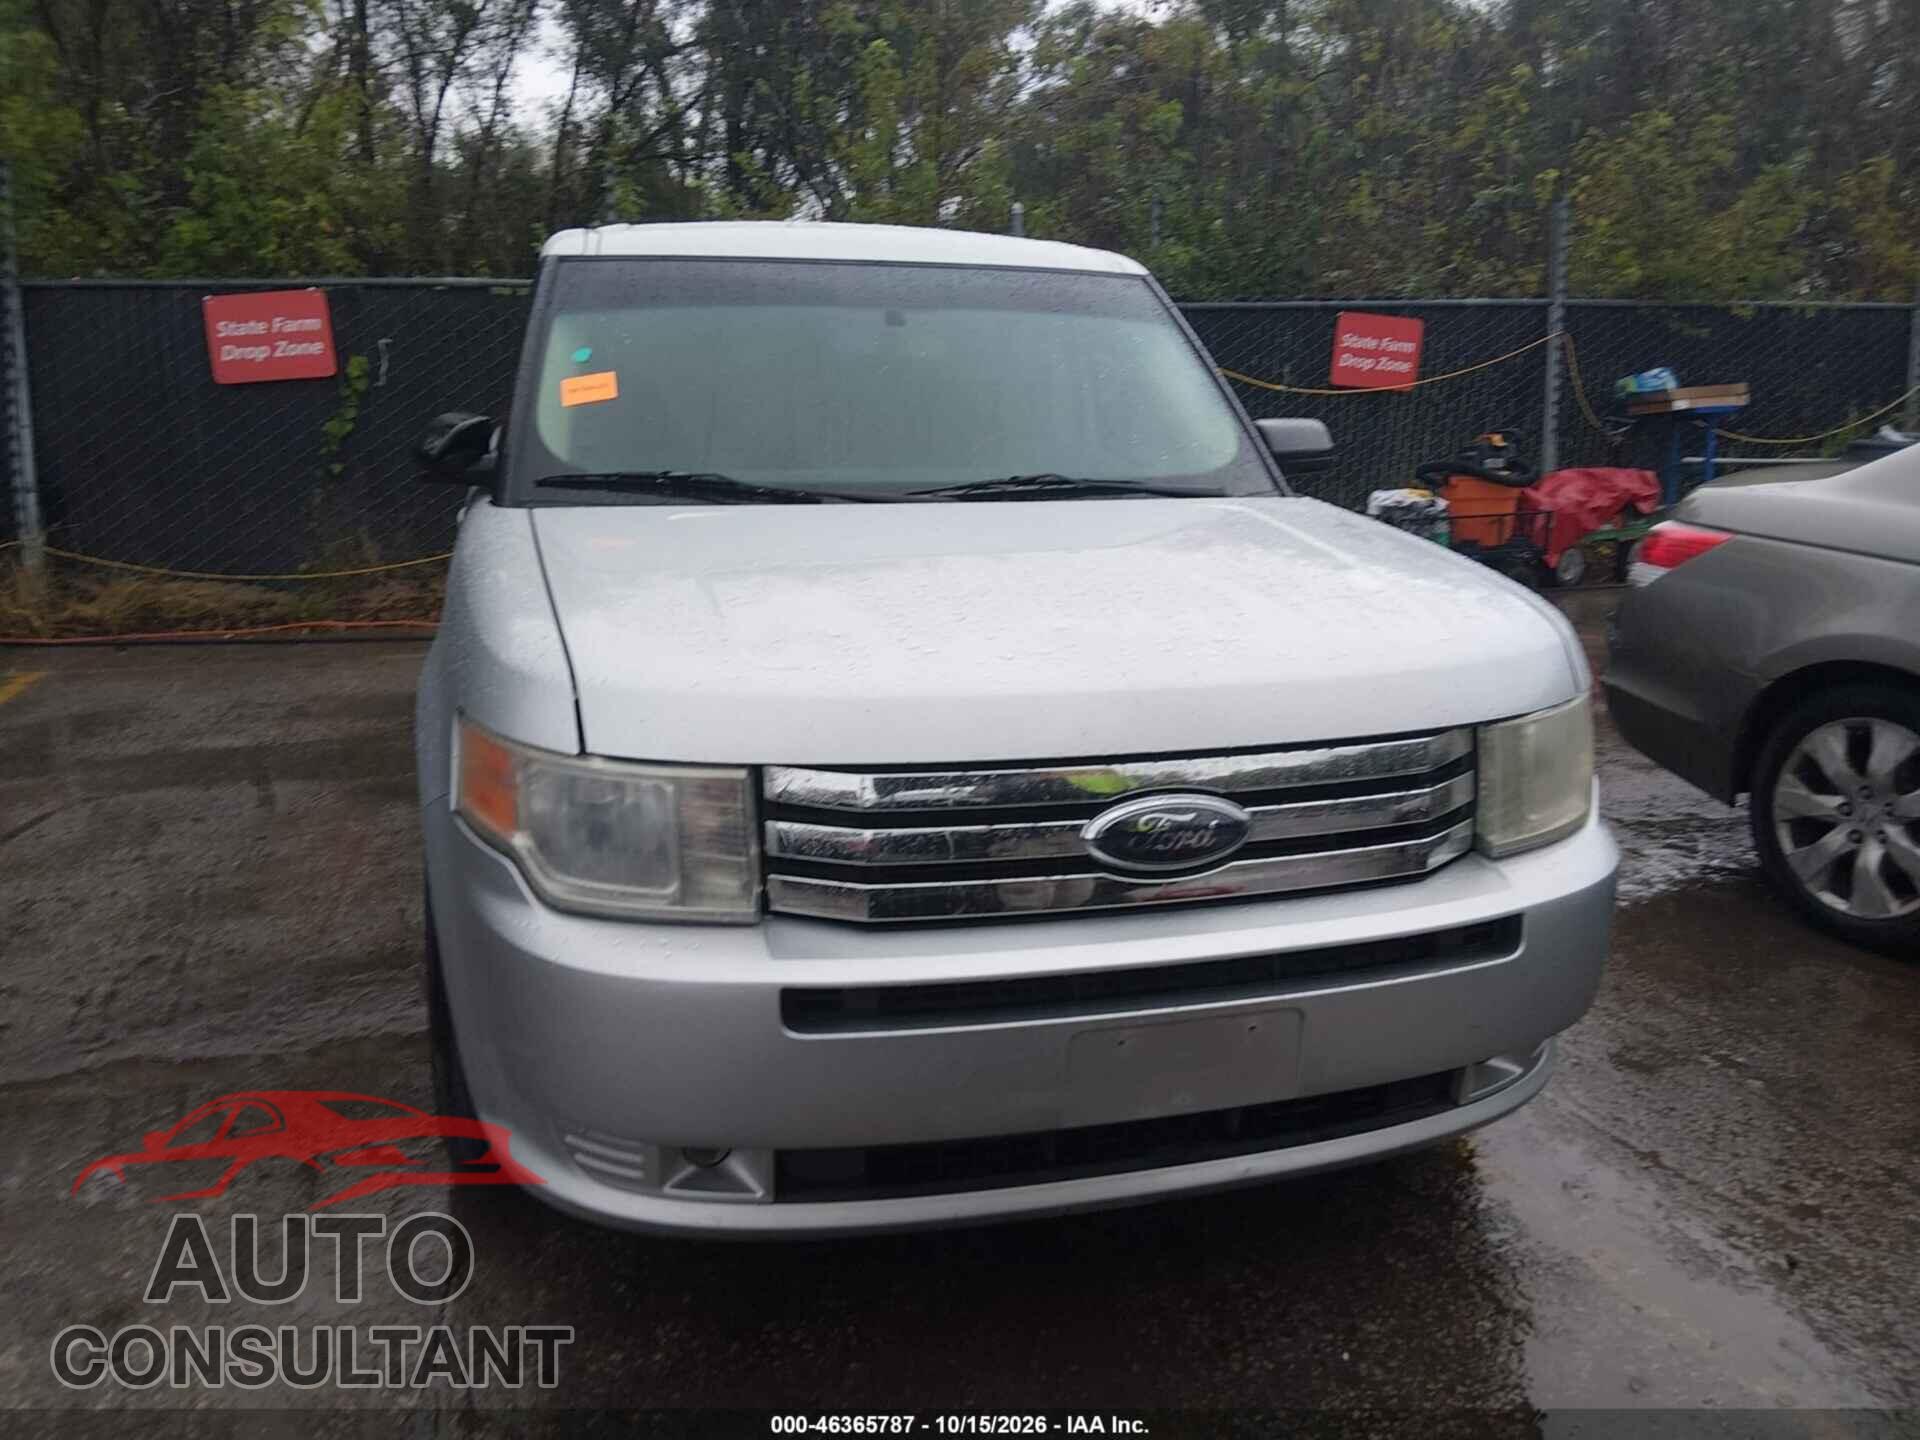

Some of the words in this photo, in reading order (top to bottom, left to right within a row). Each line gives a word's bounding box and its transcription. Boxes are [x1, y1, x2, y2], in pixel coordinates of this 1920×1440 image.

[215, 321, 269, 337] State
[271, 316, 322, 333] Farm
[221, 344, 271, 362] Drop
[272, 340, 325, 357] Zone
[1341, 333, 1378, 350] State
[1379, 337, 1417, 353] Farm
[1338, 353, 1376, 371] Drop
[1374, 356, 1413, 373] Zone
[1127, 811, 1219, 850] Ford
